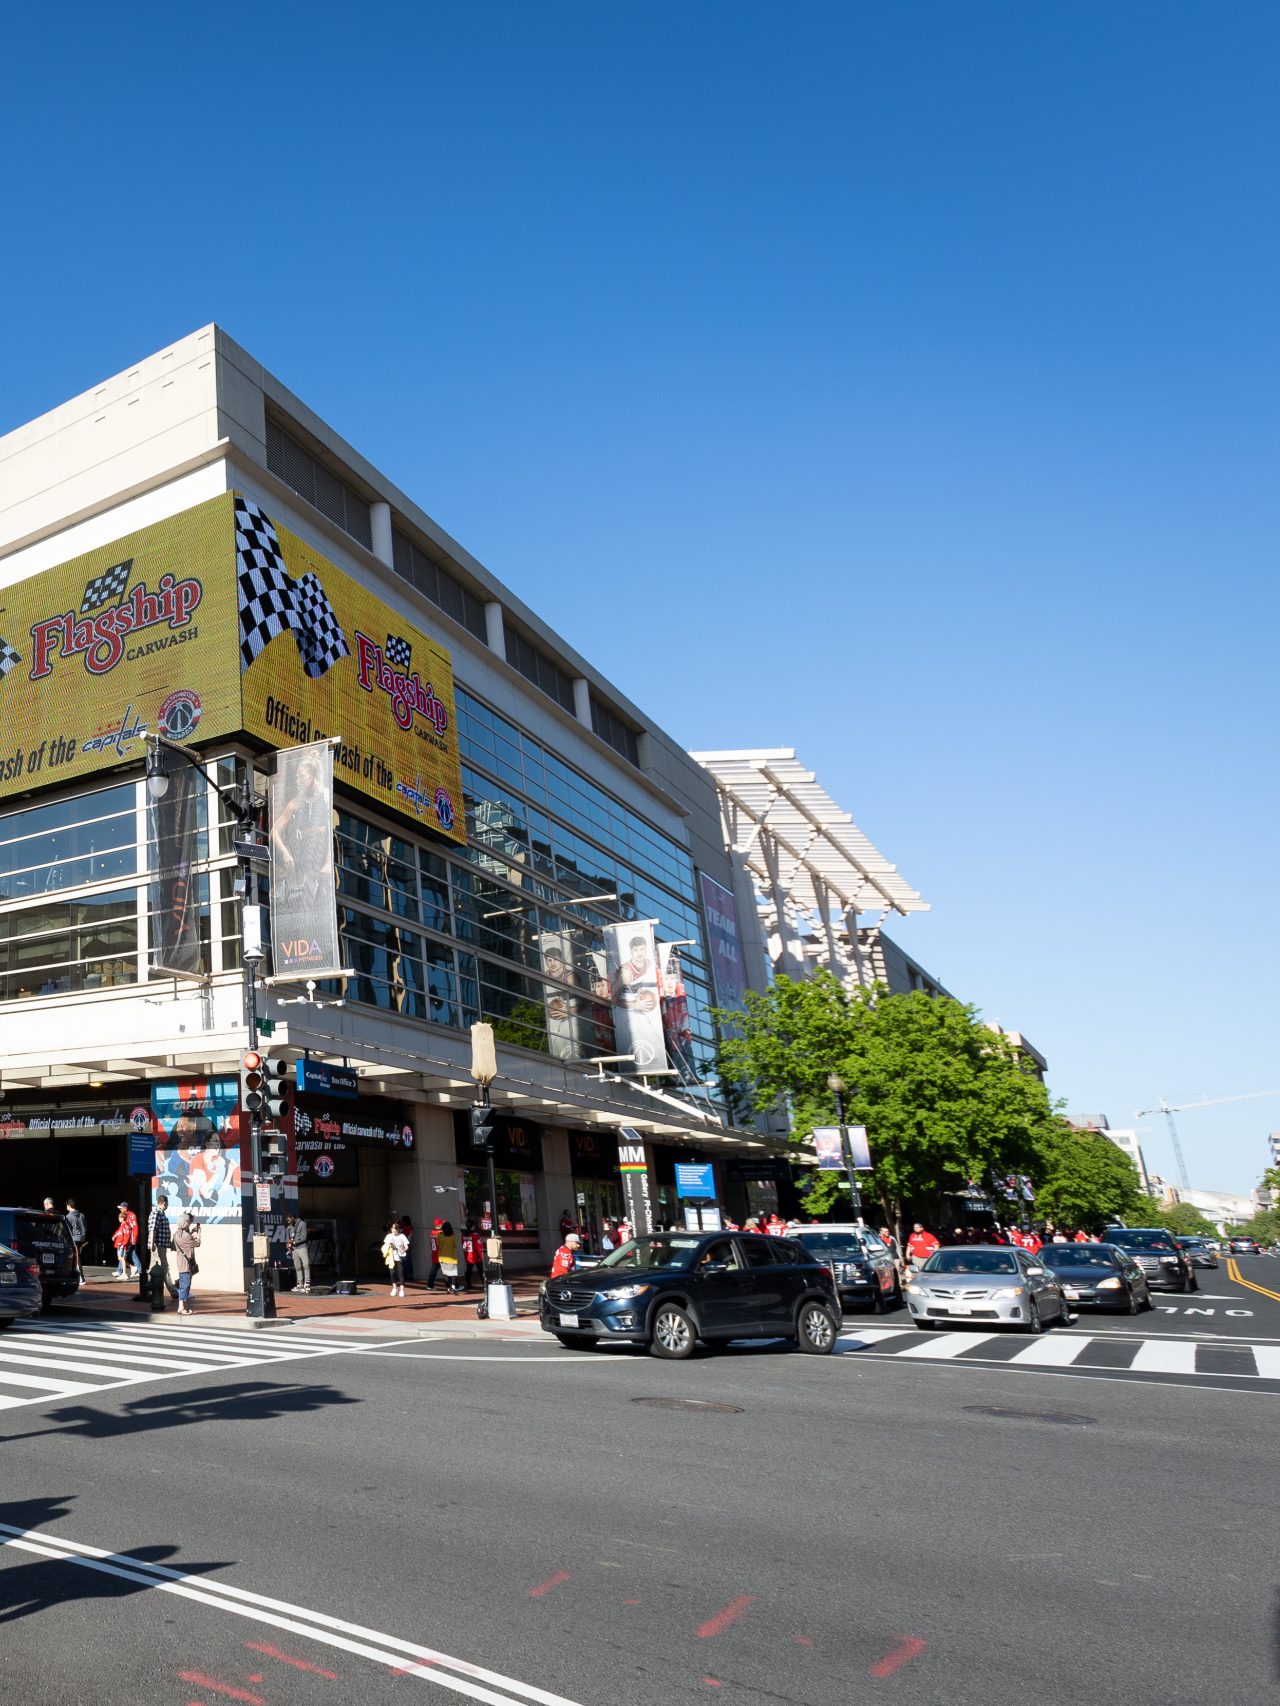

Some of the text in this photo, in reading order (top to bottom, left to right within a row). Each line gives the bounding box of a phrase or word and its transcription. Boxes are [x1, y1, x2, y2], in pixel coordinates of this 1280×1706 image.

[29, 573, 203, 681] Flagship
[126, 627, 200, 661] CARWASH
[355, 629, 448, 737] Flagship
[27, 740, 47, 773] of
[48, 735, 77, 767] the
[266, 695, 312, 743] Official
[363, 754, 375, 780] of
[376, 757, 393, 791] the
[708, 905, 736, 937] TEAM
[281, 938, 322, 958] VIDA
[173, 1099, 215, 1111] CAPITAL
[29, 1118, 51, 1131] Official
[51, 1117, 76, 1130] carwash
[76, 1117, 84, 1128] of
[84, 1115, 95, 1128] the
[342, 1122, 357, 1135] Official
[627, 1145, 646, 1163] M
[640, 1173, 649, 1199] Gallery
